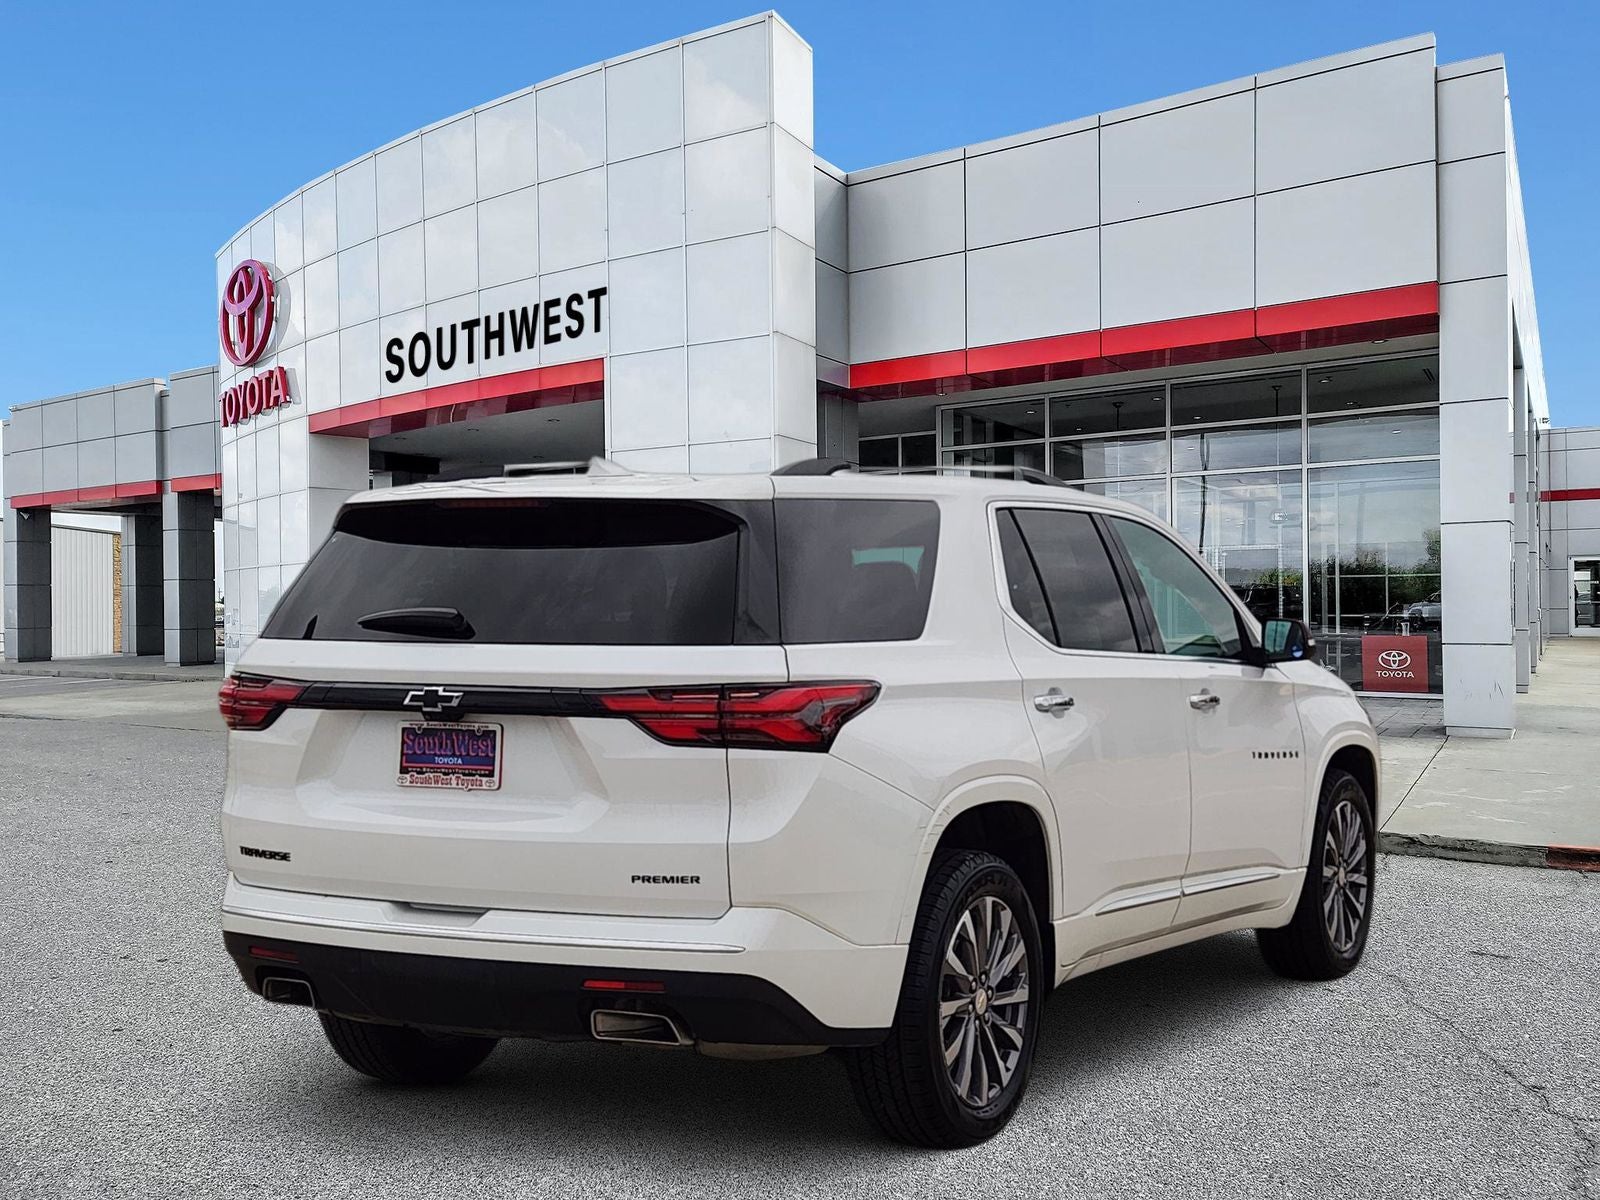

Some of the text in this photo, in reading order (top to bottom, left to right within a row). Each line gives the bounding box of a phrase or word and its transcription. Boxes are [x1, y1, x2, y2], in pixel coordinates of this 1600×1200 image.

[385, 286, 608, 384] SOUTHWEST
[218, 366, 292, 428] TOYOTA
[1375, 670, 1415, 678] TOYOTA
[434, 756, 463, 765] TOYOTA
[409, 774, 483, 789] SouthWest Toyota
[631, 875, 701, 884] PREMIER
